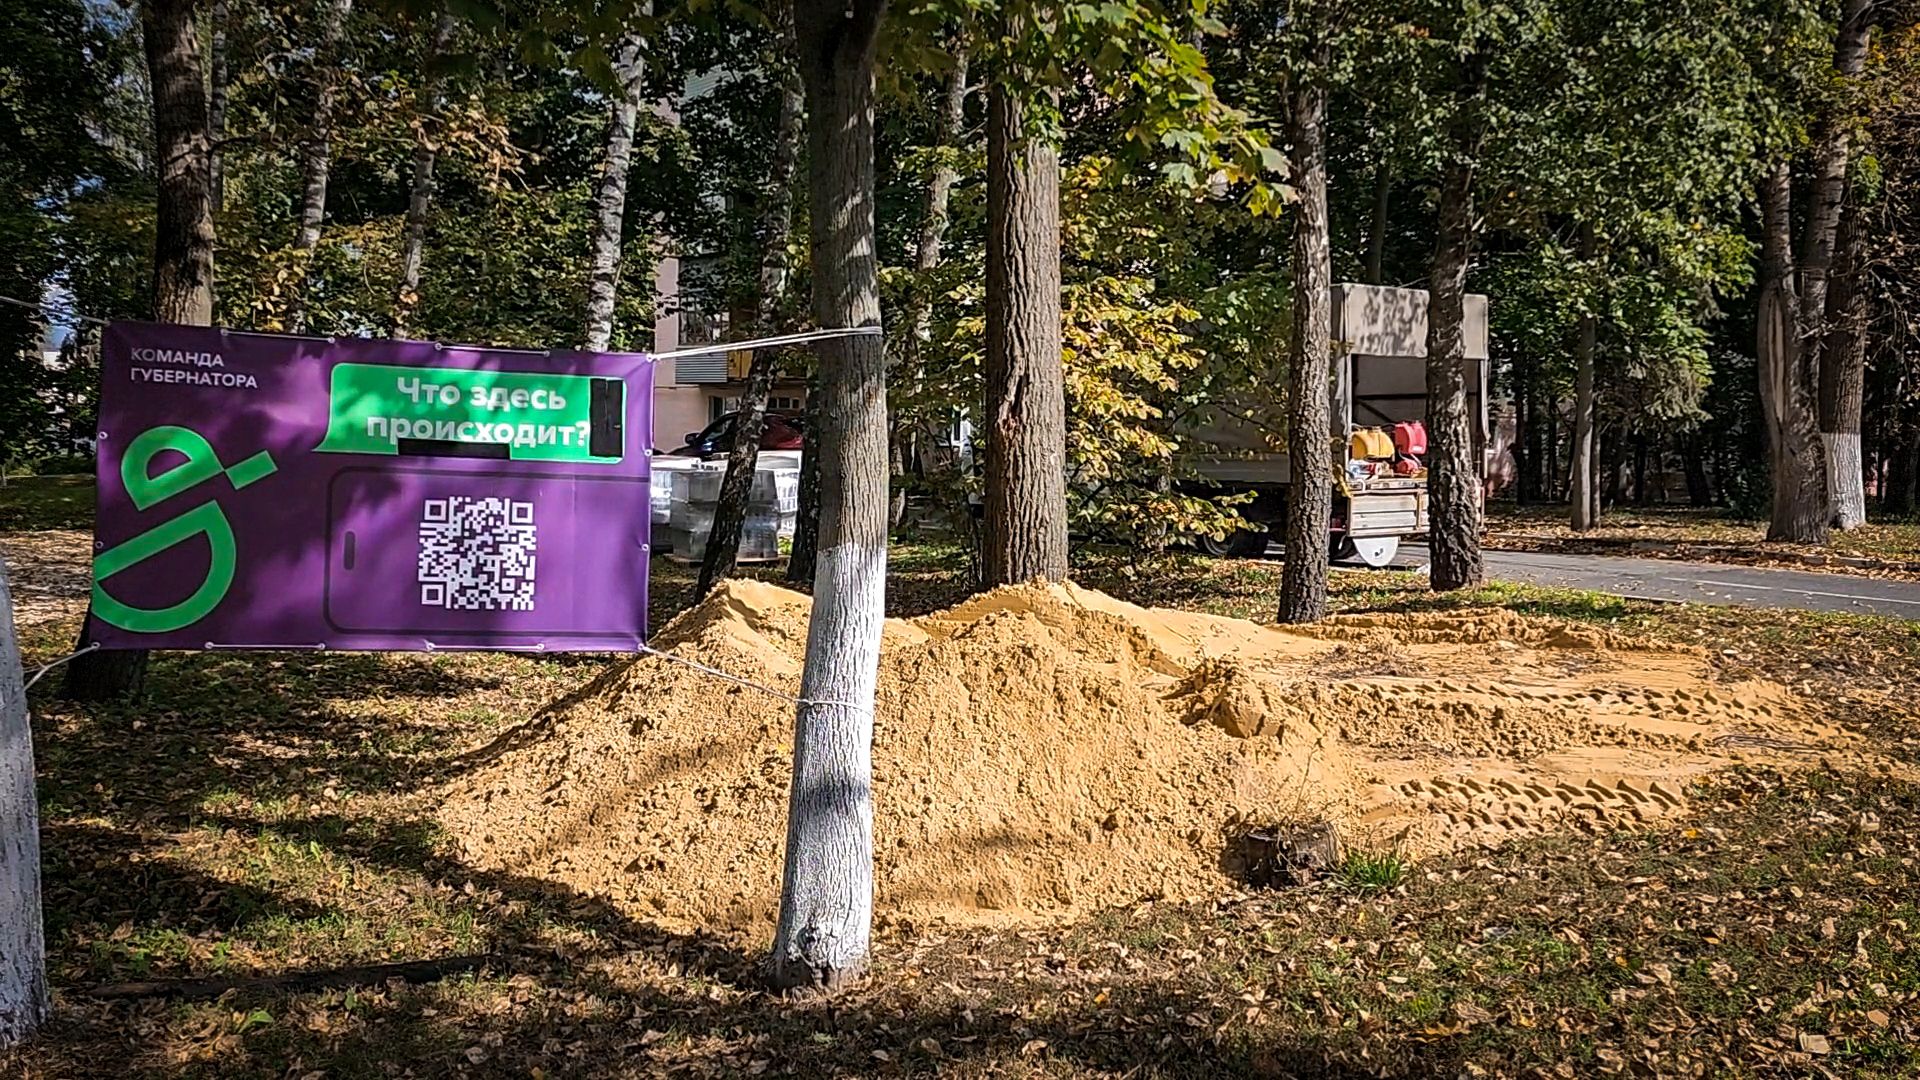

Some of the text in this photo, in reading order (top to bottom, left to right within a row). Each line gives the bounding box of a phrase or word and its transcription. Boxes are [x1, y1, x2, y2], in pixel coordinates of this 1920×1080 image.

[130, 347, 225, 368] КОМАНДА
[130, 367, 258, 389] ГУБЕРНАТОРА
[397, 376, 567, 412] Что здесь
[367, 416, 591, 448] происходит?
